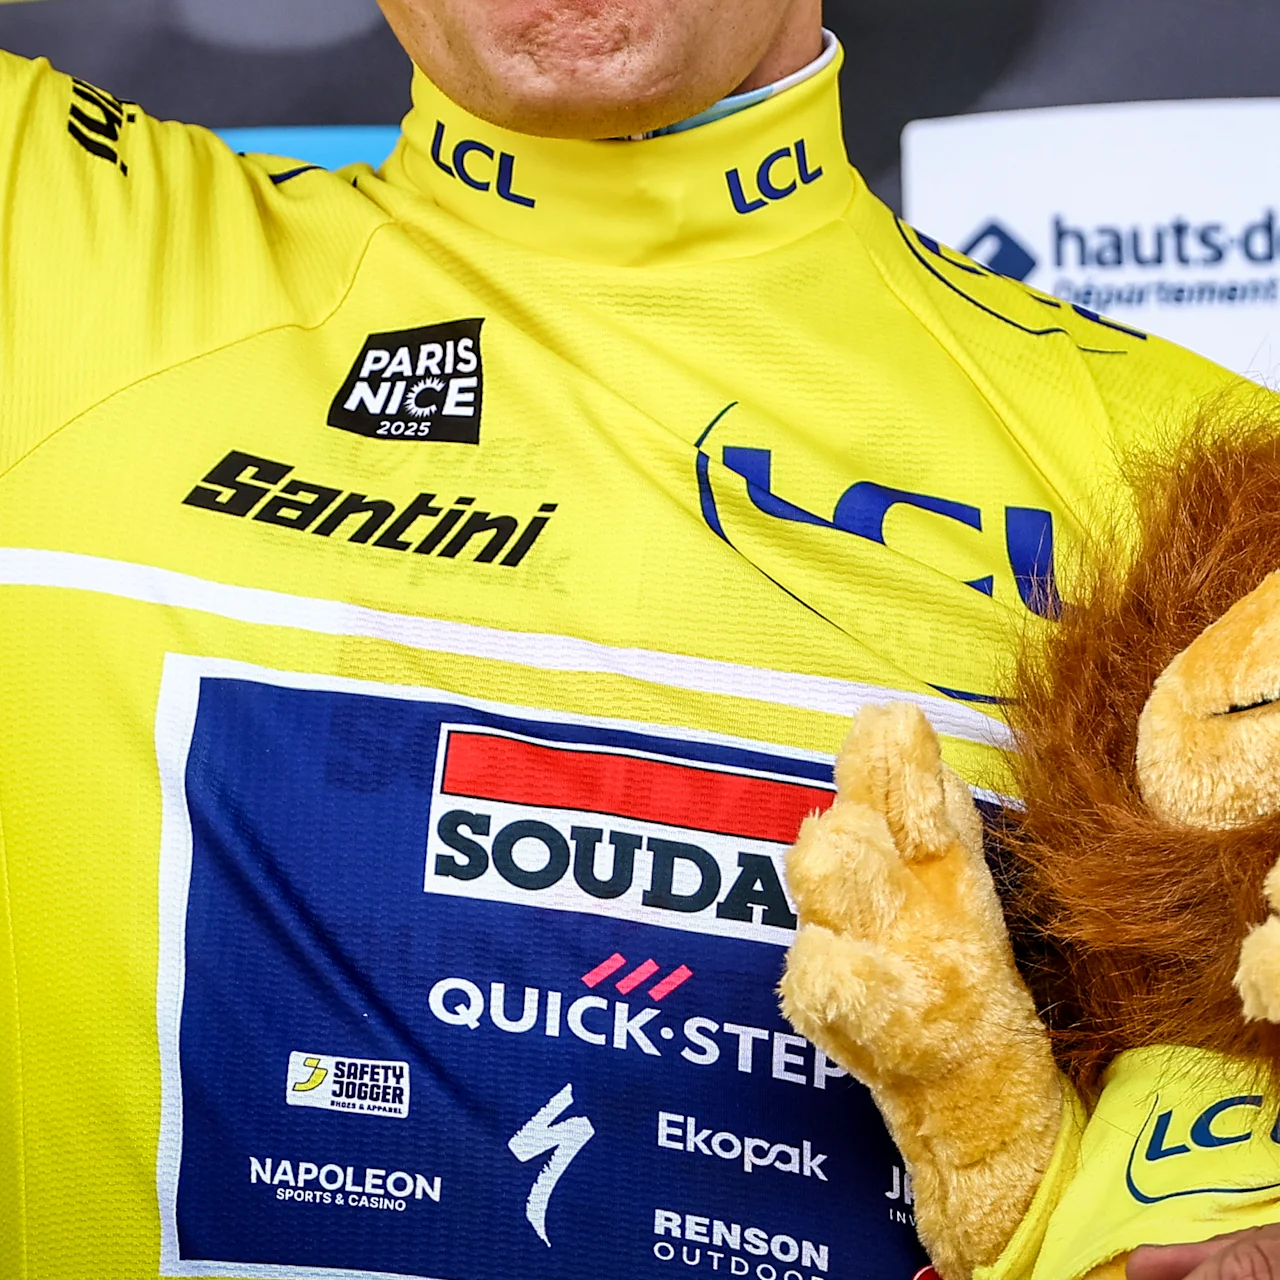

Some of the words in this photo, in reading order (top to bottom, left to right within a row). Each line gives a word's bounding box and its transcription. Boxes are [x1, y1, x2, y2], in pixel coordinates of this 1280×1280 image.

[431, 120, 537, 210] LCL
[725, 138, 824, 215] LCL
[359, 337, 478, 378] PARIS
[342, 376, 478, 417] NICE
[375, 420, 432, 436] 2025
[182, 449, 559, 568] Santini
[434, 809, 798, 932] SOUDA
[331, 1079, 404, 1105] JOGGER
[333, 1061, 404, 1085] SAFETY
[330, 1099, 356, 1110] SHOES
[366, 1104, 403, 1115] APPAREL
[656, 1110, 829, 1182] Ekopak
[249, 1156, 442, 1203] NAPOLEON
[276, 1187, 332, 1204] SPORTS
[334, 1192, 345, 1206] &
[348, 1194, 407, 1212] CASINO
[653, 1208, 829, 1273] RENSON
